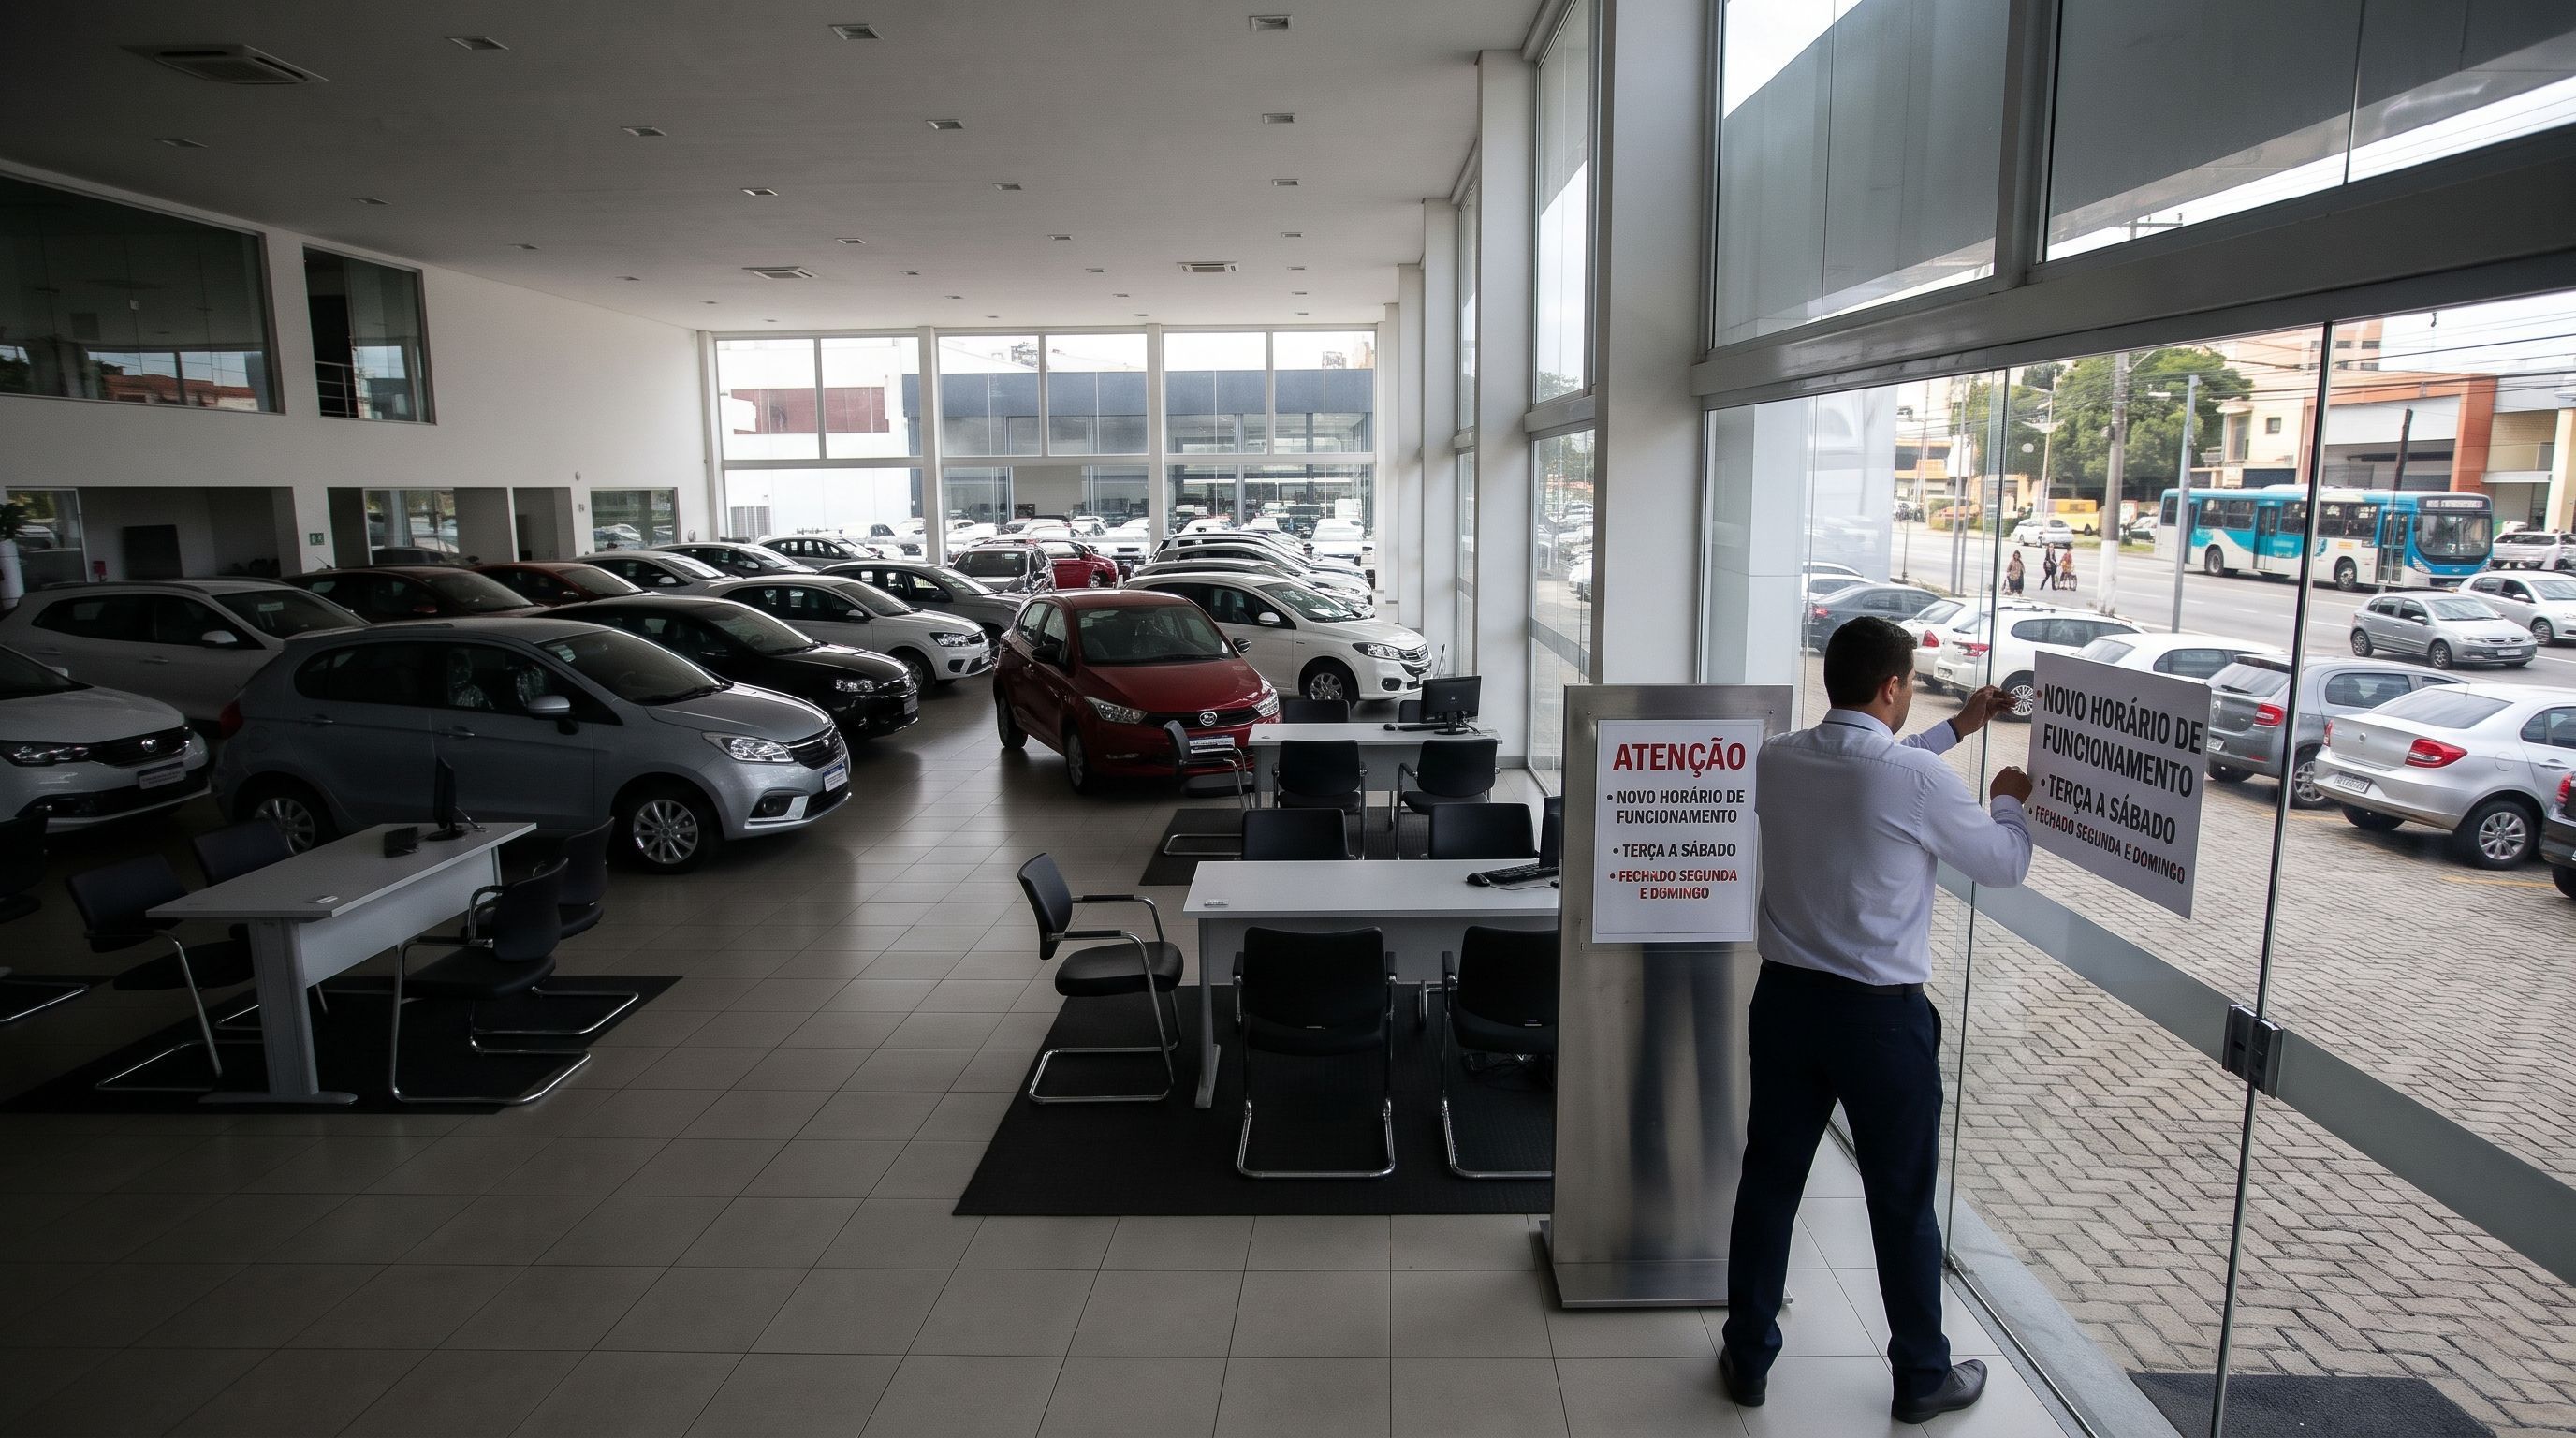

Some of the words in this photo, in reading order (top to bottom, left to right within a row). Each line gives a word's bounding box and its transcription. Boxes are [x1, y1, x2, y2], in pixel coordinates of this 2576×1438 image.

[2043, 683, 2086, 721] NOVO
[2090, 696, 2171, 745] HORÁRIO
[2174, 716, 2203, 755] DE
[1612, 736, 1747, 778] ATENÇÃO
[2042, 723, 2193, 798] FUNCIONAMENTO
[1617, 789, 1656, 804] NOVO
[1660, 786, 1723, 804] HORÁRIO
[1726, 789, 1745, 804] DE
[2048, 774, 2092, 815] TERÇA
[2095, 792, 2105, 819] A
[2109, 793, 2176, 845] SÁBADO
[1617, 809, 1737, 824] FUNCIONAMENTO
[1622, 843, 1665, 861] TERÇA
[1667, 844, 1678, 858] A
[1681, 840, 1736, 858] SÁBADO
[2035, 805, 2074, 835] FECHADO
[2075, 824, 2121, 857] SEGUNDA
[2124, 843, 2132, 861] E
[2132, 845, 2186, 885] DOMINGO
[1678, 869, 1738, 882] SEGUNDA
[1639, 887, 1647, 900] E
